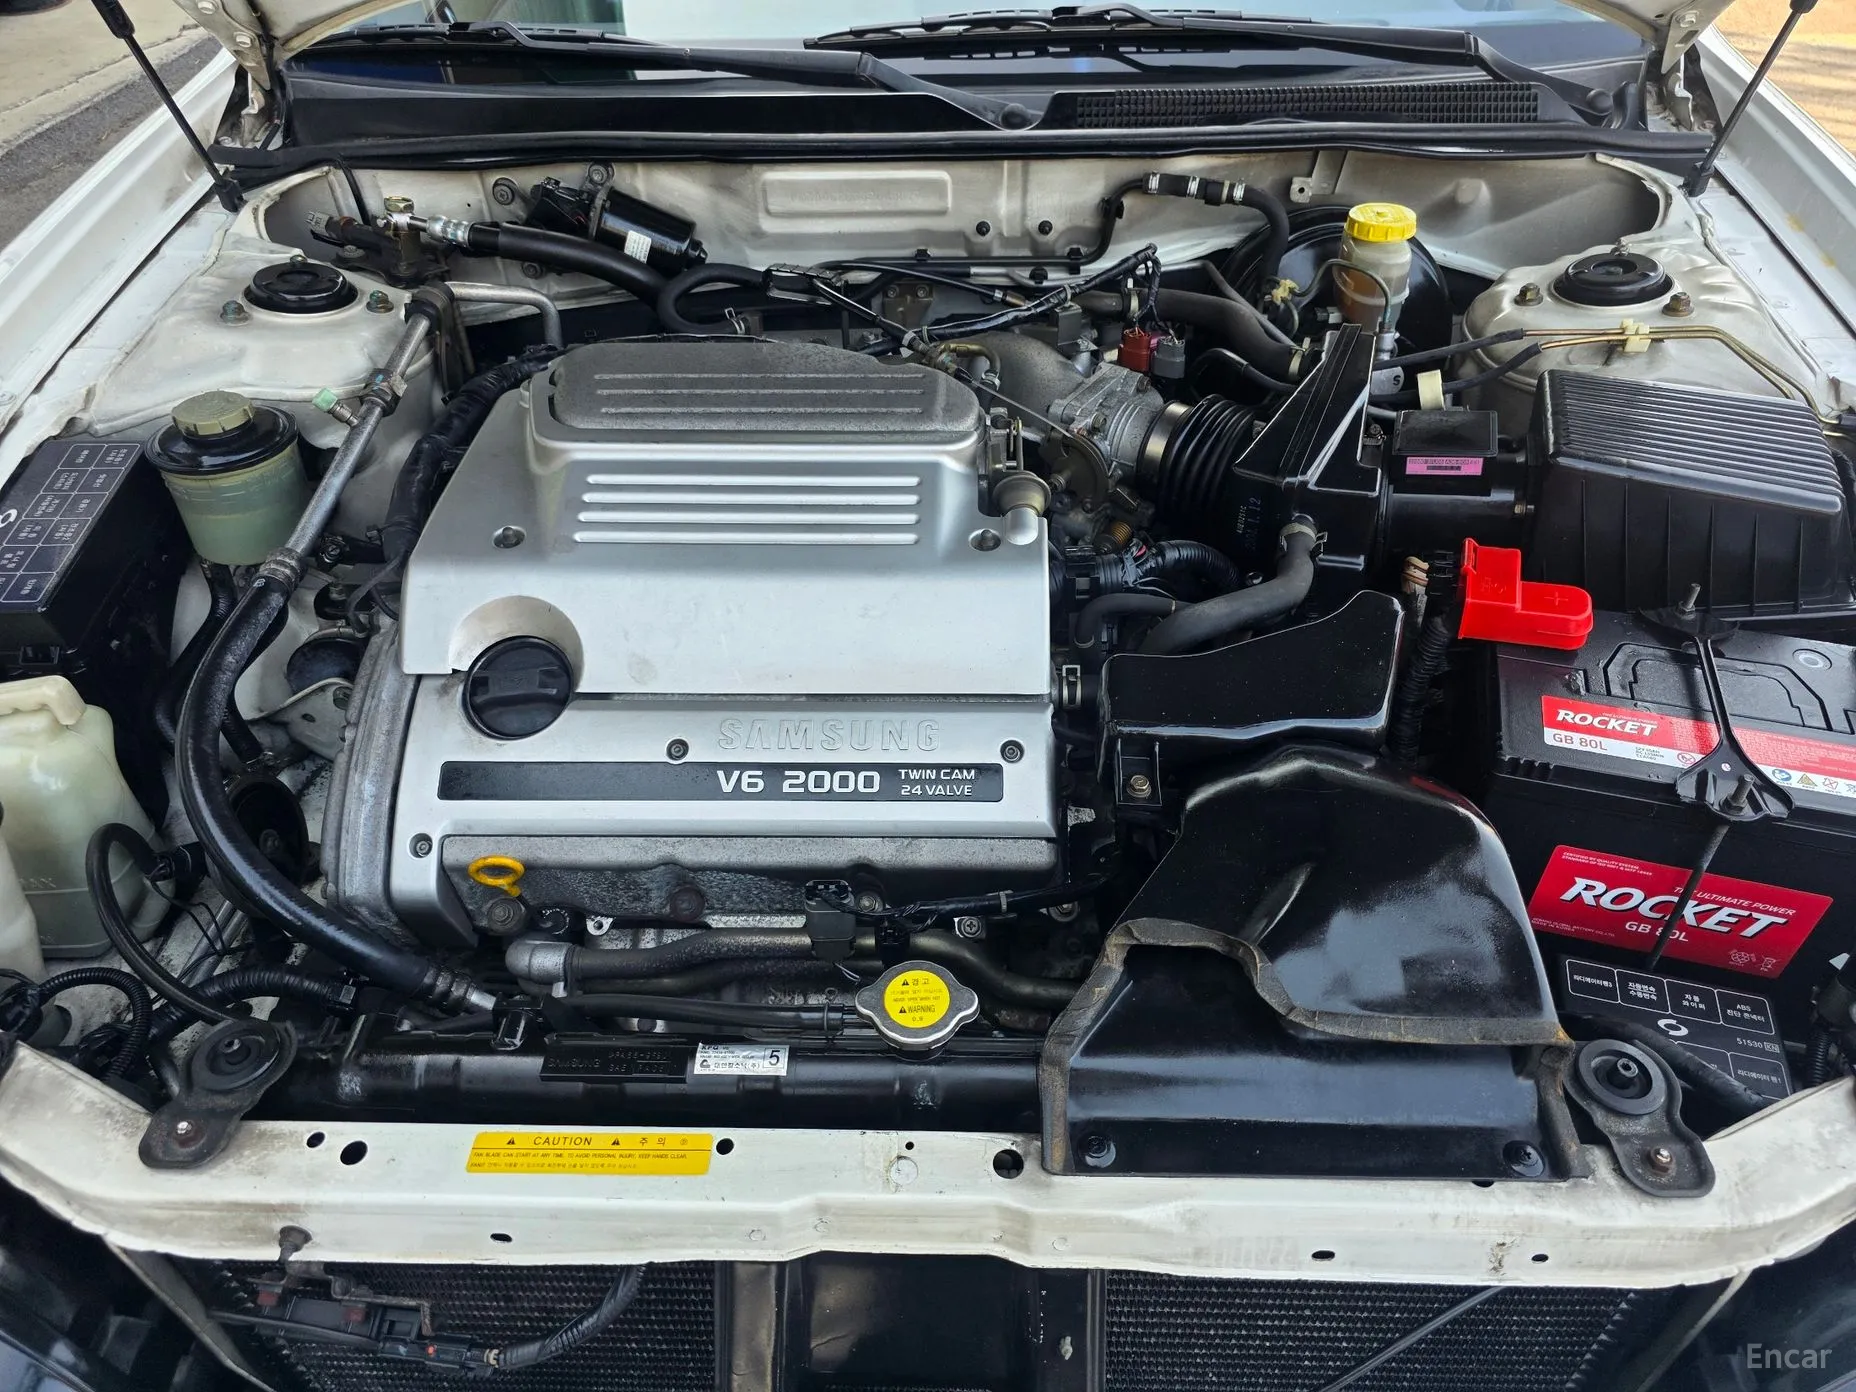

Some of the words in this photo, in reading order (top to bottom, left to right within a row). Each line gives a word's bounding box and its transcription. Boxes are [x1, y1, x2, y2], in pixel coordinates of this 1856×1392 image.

[1556, 709, 1659, 736] ROCKET
[718, 719, 940, 751] SAMSUNG
[1552, 733, 1574, 745] GB
[1579, 738, 1608, 751] 80L
[717, 770, 765, 793] V6
[782, 770, 881, 793] 2000
[898, 769, 936, 780] TWIN
[940, 769, 975, 780] CAM
[901, 785, 922, 796] 24
[925, 785, 973, 796] VALVE
[1559, 876, 1789, 939] ROCKET
[1696, 891, 1752, 907] ULTIMATE
[1753, 901, 1797, 916] POWER
[1624, 921, 1652, 934] GB
[908, 1005, 936, 1013] WARNING
[1736, 1004, 1752, 1012] ABS
[1736, 1037, 1763, 1048] 51530
[768, 1049, 781, 1066] 5
[533, 1136, 593, 1146] CAUTION
